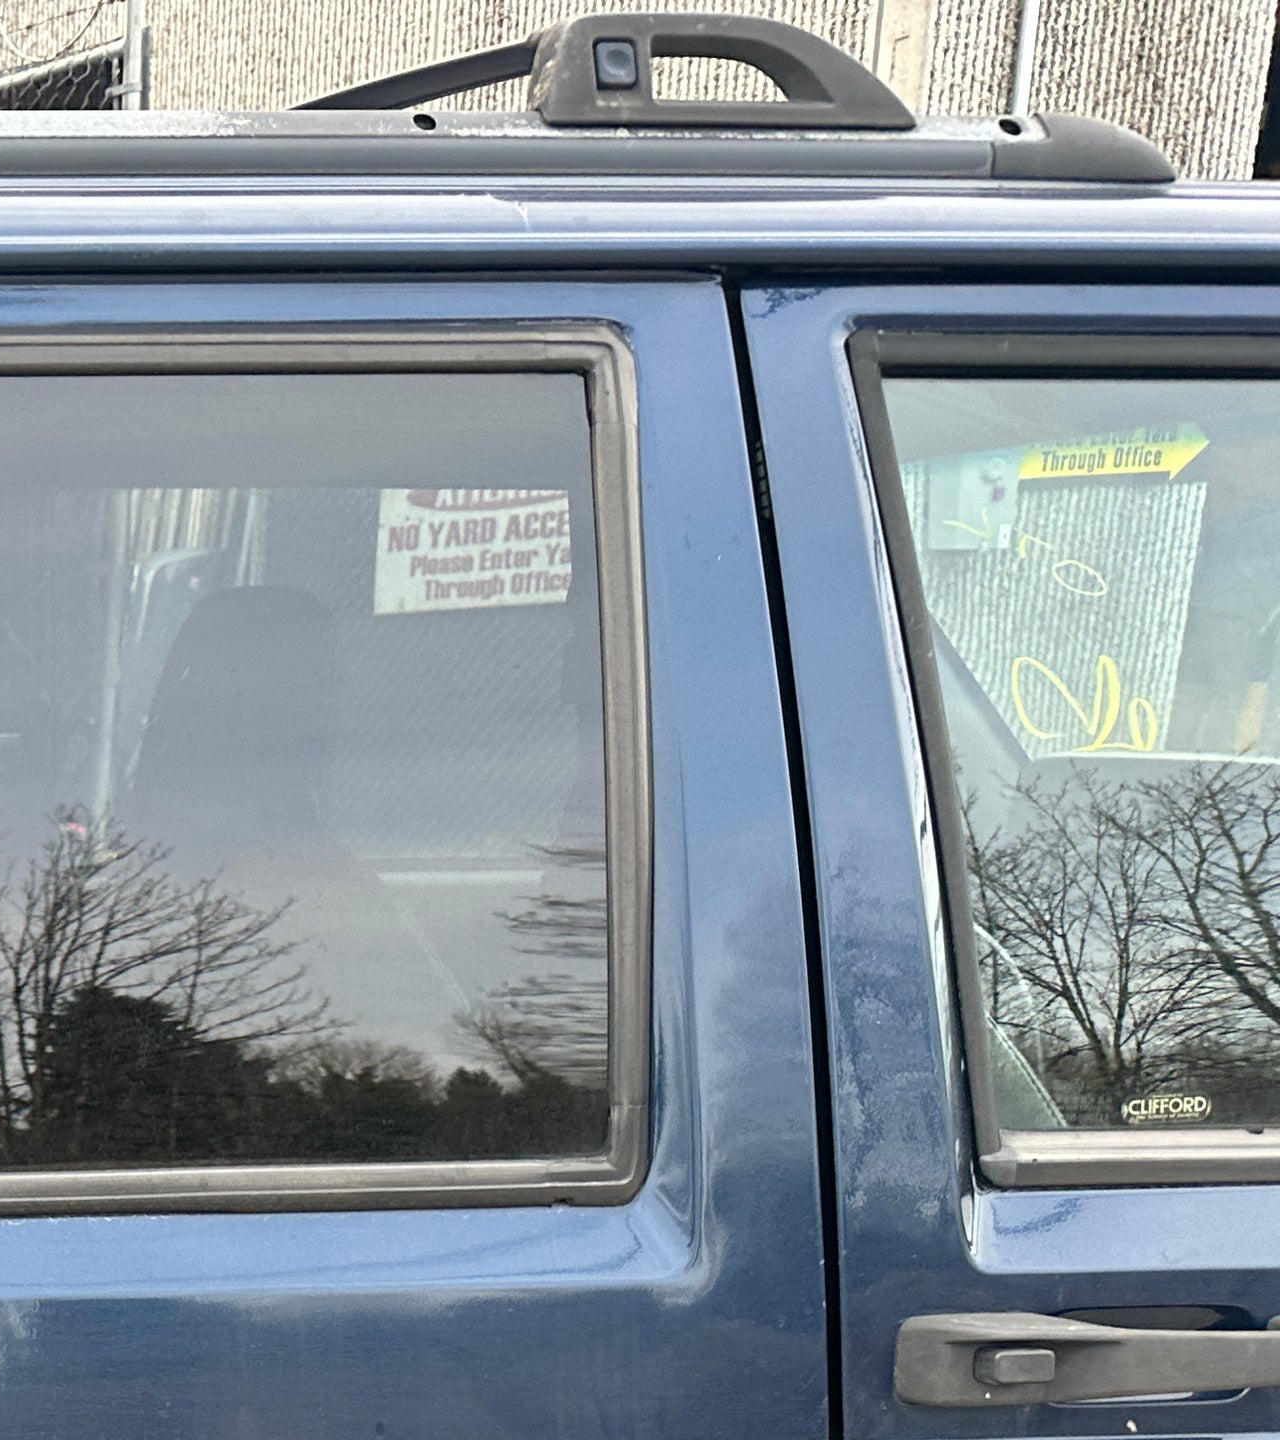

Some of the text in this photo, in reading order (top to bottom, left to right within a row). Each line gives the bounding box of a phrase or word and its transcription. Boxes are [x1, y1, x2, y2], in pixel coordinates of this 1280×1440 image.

[1042, 448, 1162, 472] Through Office
[388, 521, 419, 552] NO
[429, 516, 497, 549] YARD
[410, 552, 474, 577] Please
[479, 548, 539, 573] Enter
[426, 576, 504, 600] Through
[1128, 1097, 1206, 1114] CLIFFORD
